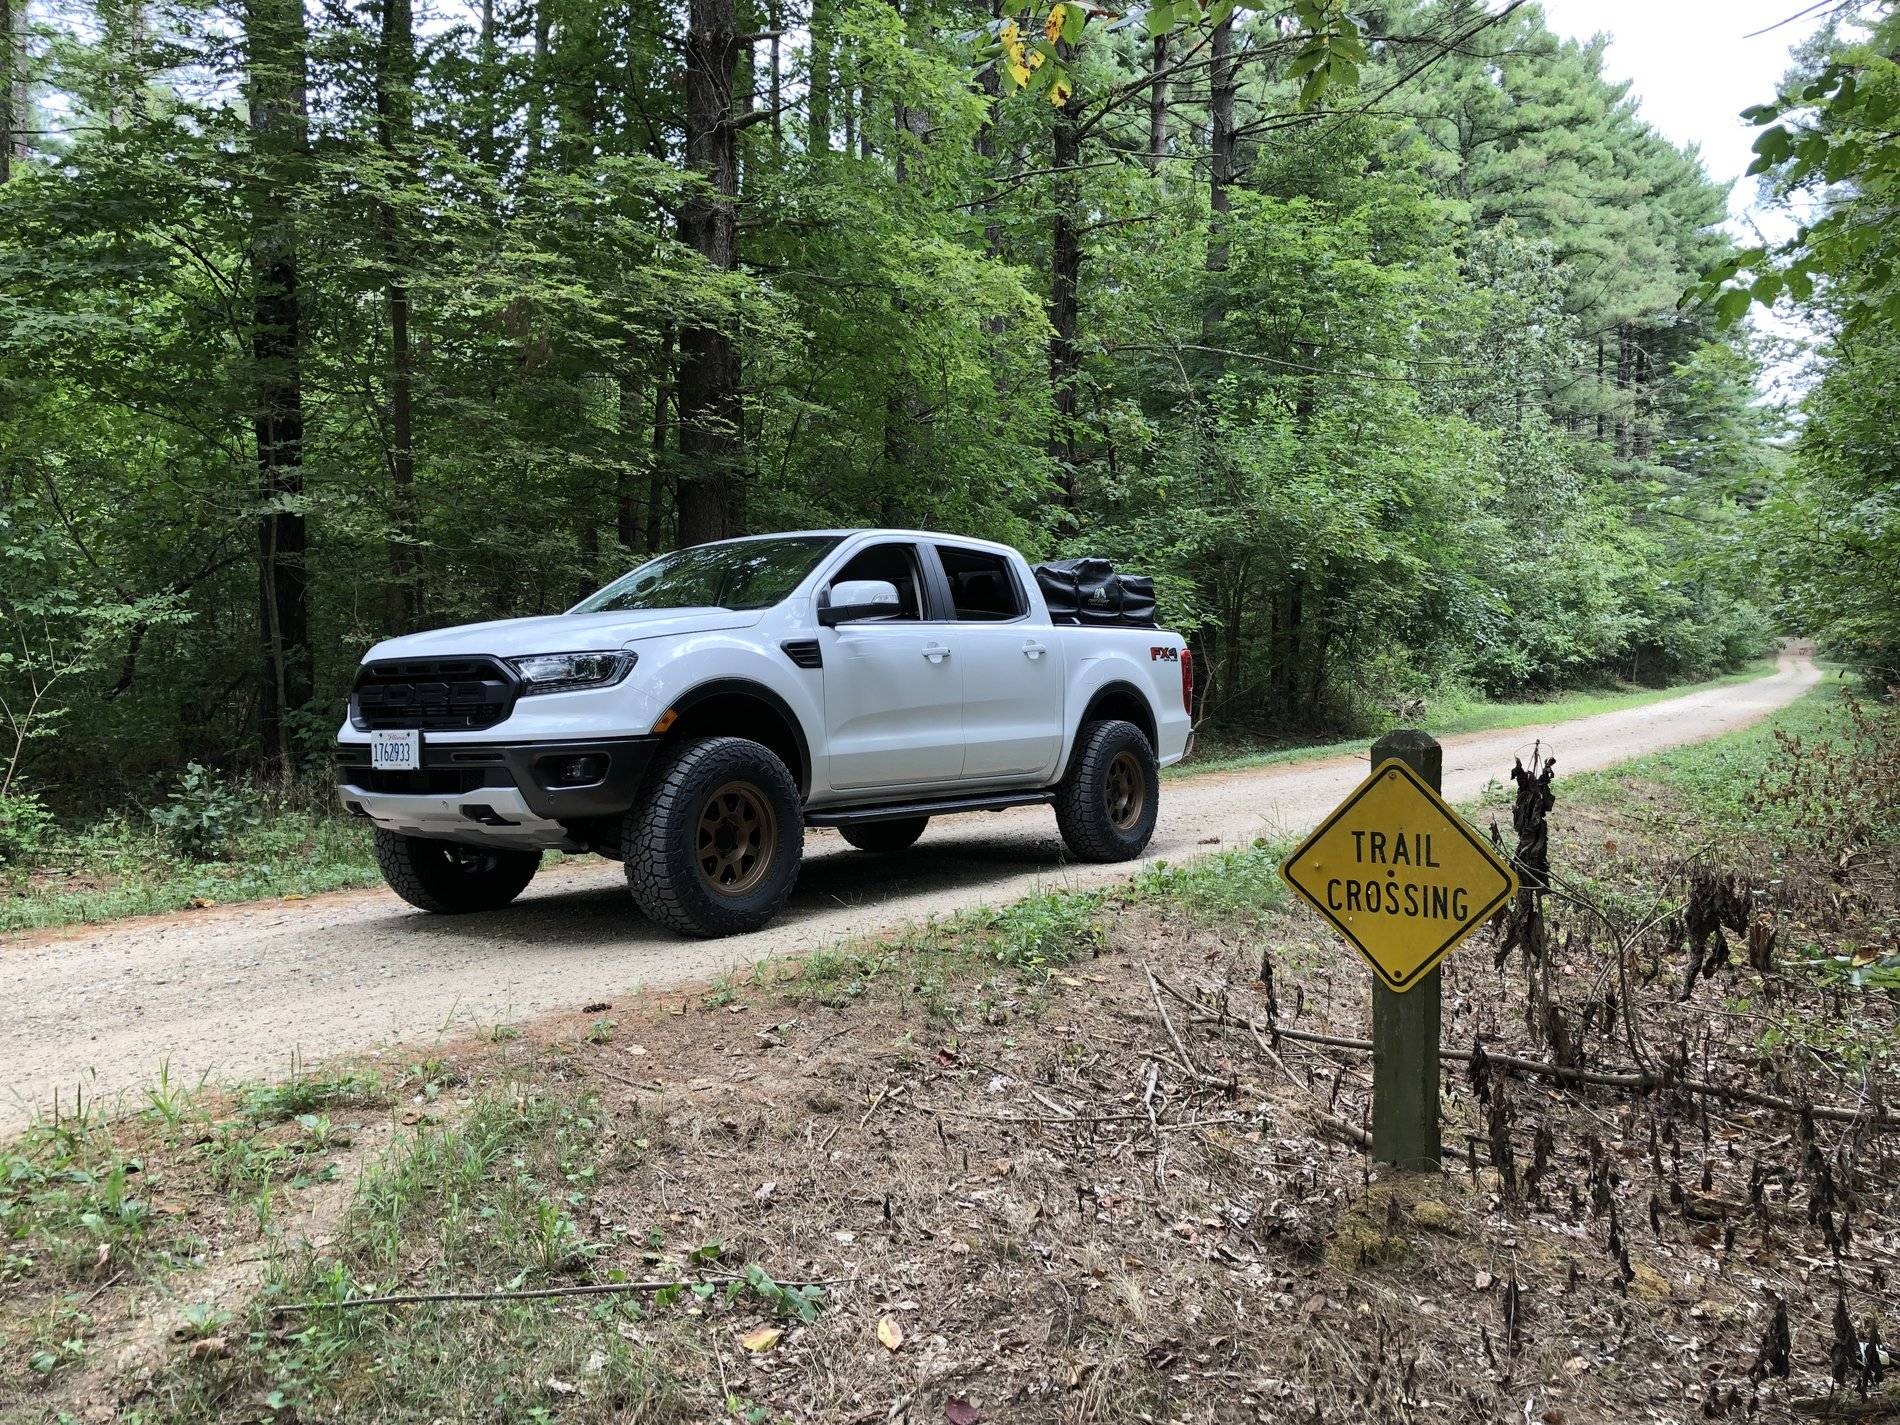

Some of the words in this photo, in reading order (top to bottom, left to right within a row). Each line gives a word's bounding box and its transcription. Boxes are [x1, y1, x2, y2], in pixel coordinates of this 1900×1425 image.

[1150, 646, 1178, 661] FX4
[374, 743, 410, 761] 1762933
[1351, 830, 1440, 868] TRAIL
[1327, 878, 1468, 922] CROSSING
